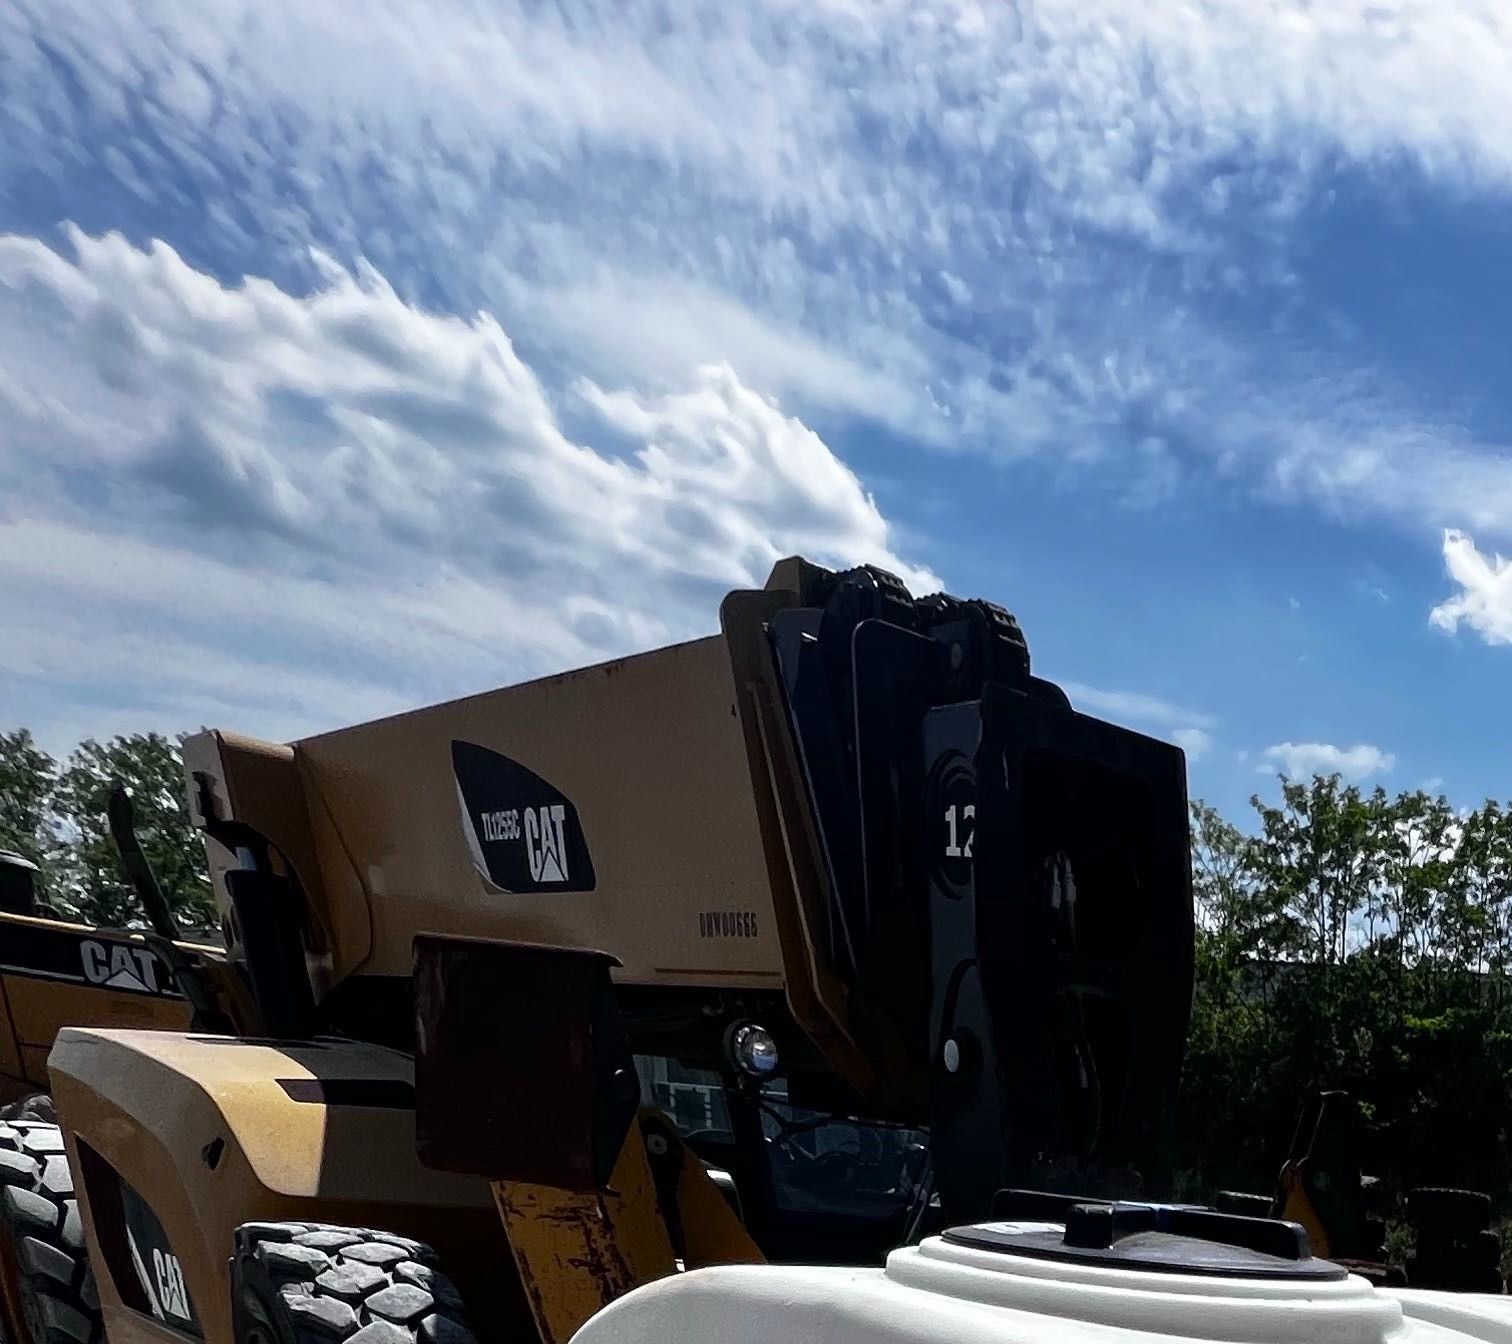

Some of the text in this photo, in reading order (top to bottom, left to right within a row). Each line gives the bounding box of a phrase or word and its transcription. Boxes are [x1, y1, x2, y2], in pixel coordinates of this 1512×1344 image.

[481, 808, 521, 842] TL1255C
[524, 804, 569, 883] CAT
[80, 940, 159, 993] CAT
[153, 1248, 192, 1321] CAT
